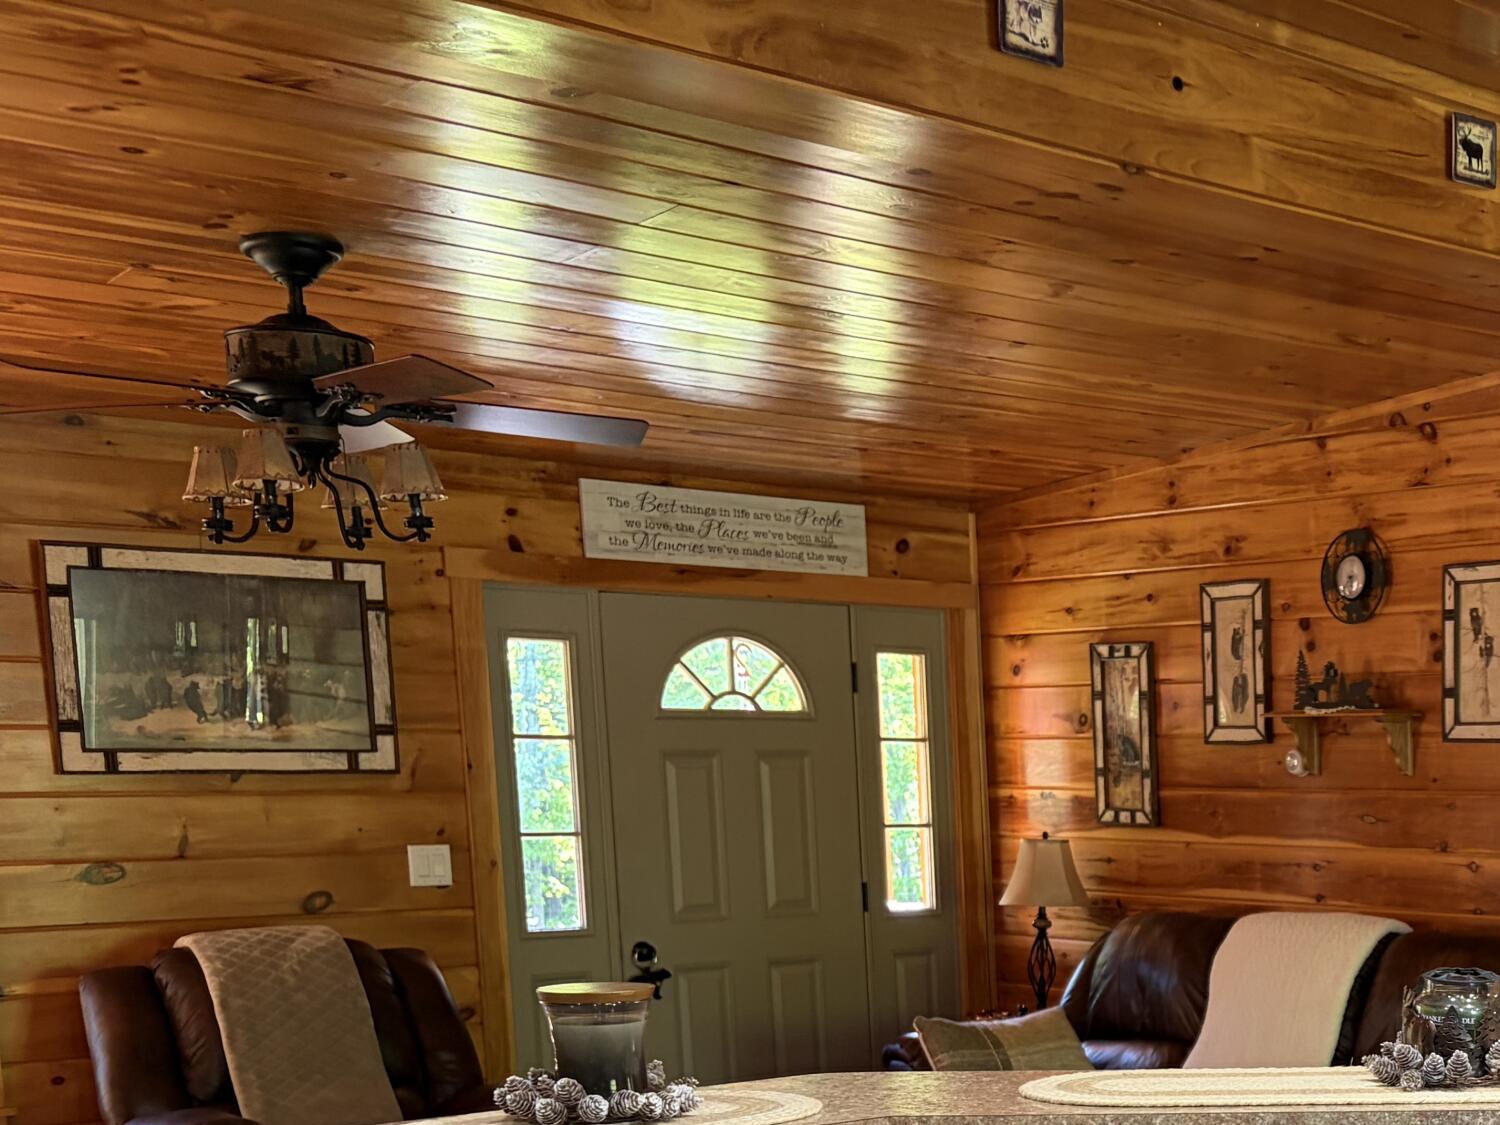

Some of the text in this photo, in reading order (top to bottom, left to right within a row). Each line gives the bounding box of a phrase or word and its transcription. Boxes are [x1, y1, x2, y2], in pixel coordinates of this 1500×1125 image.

[606, 491, 844, 533] The Best things in life are the People
[608, 531, 848, 565] the Memories we've made along the way
[624, 519, 834, 545] we love, the Places we've been and
